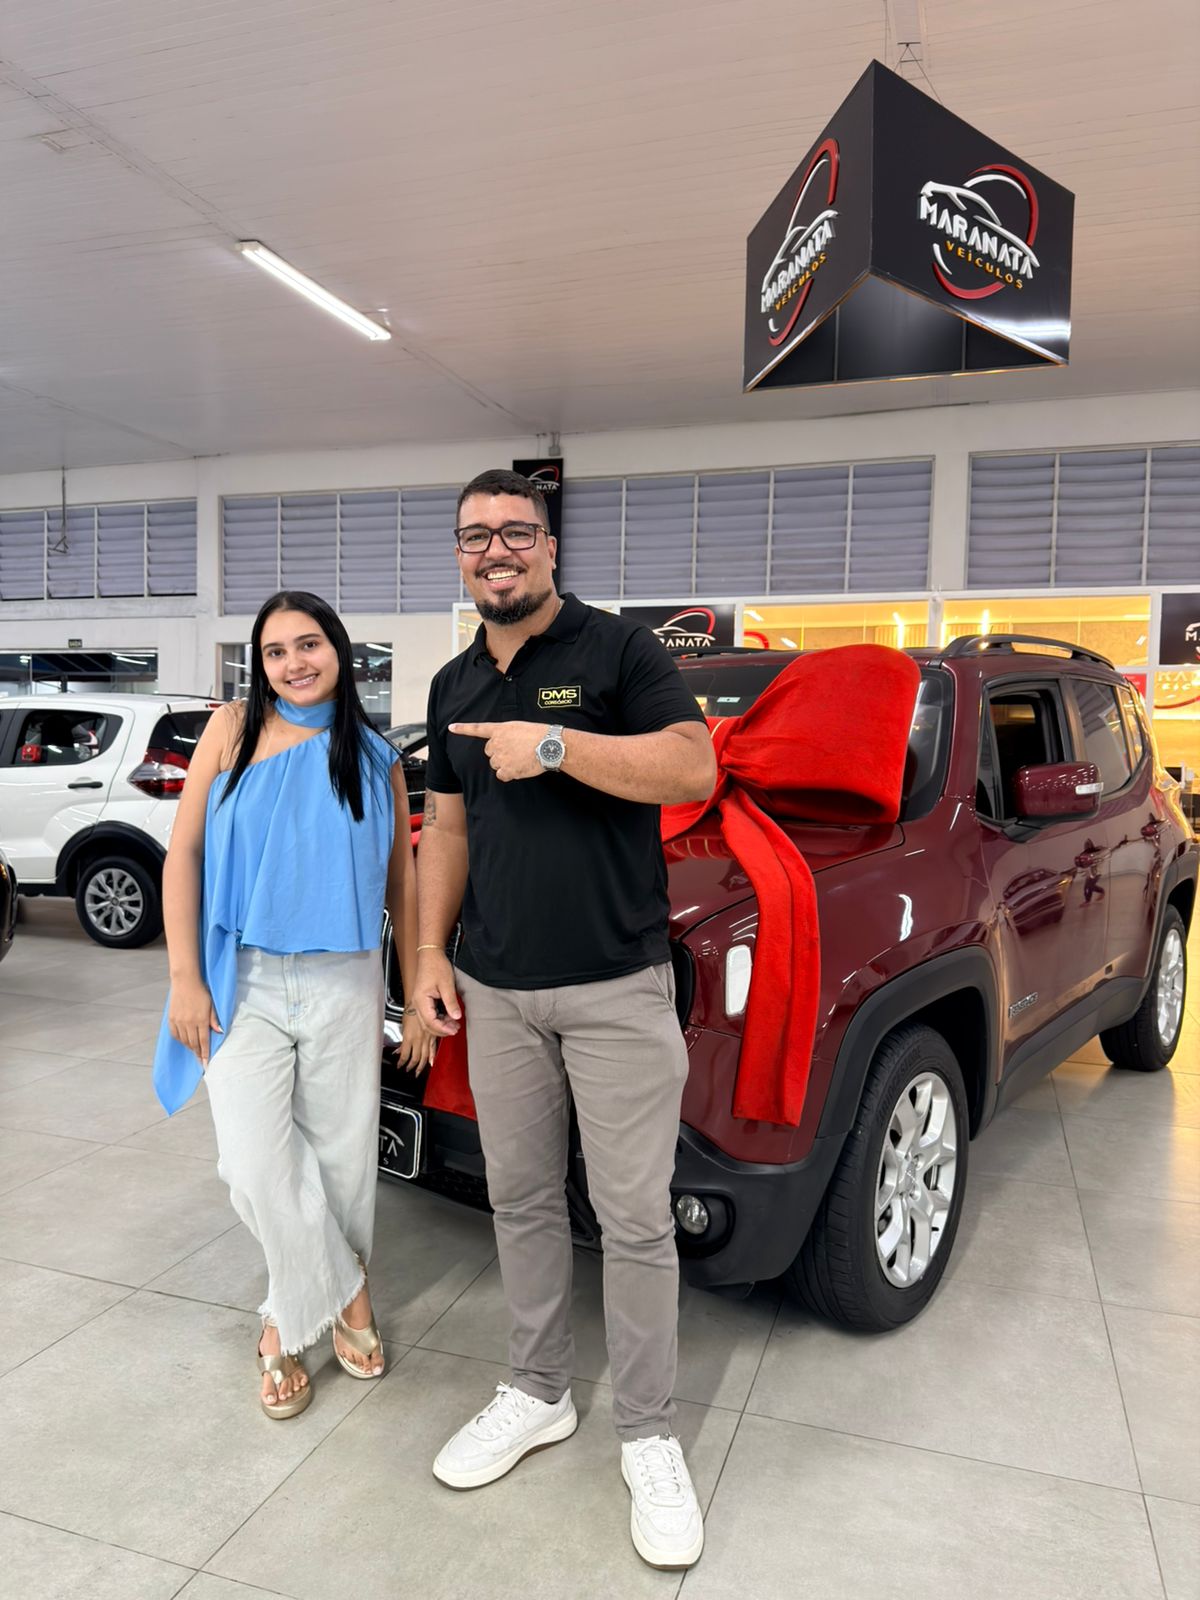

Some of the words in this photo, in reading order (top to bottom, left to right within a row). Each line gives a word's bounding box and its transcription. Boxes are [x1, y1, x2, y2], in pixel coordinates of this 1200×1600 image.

[761, 219, 834, 313] MARANATA
[919, 195, 1034, 279] MARANATA
[541, 689, 577, 700] DMS
